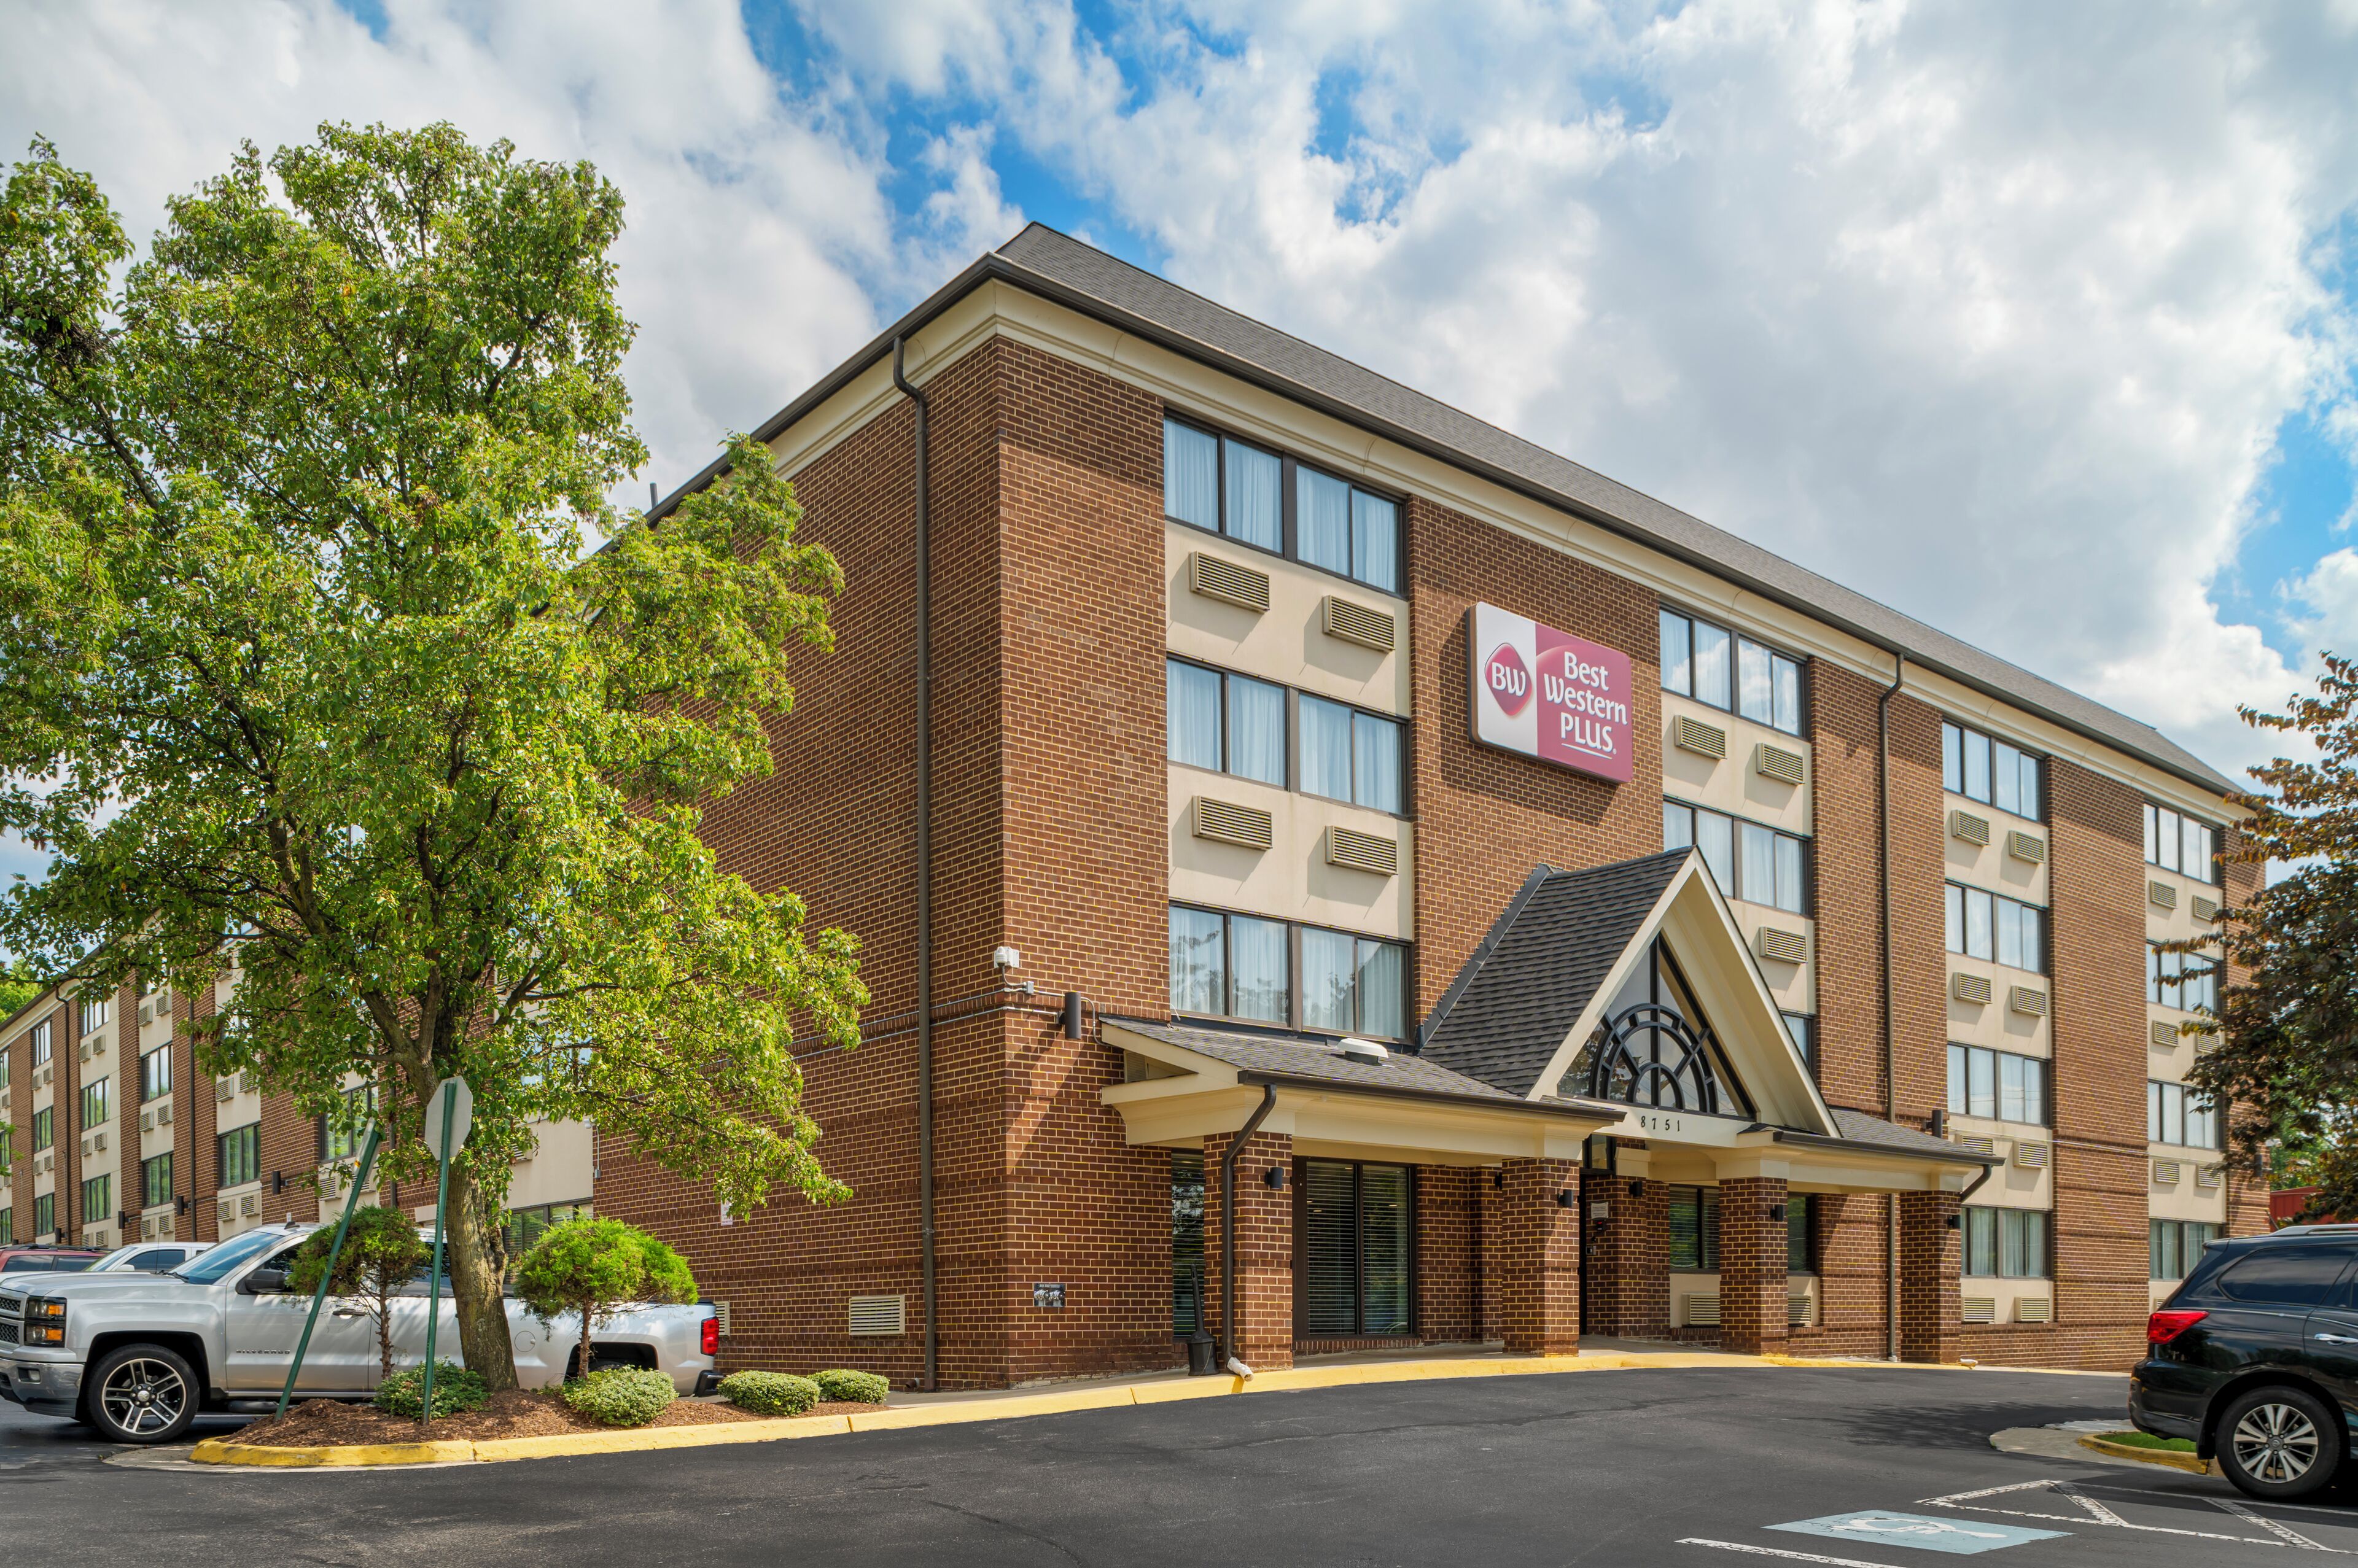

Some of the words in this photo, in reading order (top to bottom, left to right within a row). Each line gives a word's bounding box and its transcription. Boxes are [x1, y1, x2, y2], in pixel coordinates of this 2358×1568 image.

[1492, 662, 1526, 697] BW
[1564, 651, 1609, 691] Best
[1544, 673, 1627, 725] Western
[1561, 712, 1613, 753] PLUS
[1640, 1116, 1680, 1131] 8751
